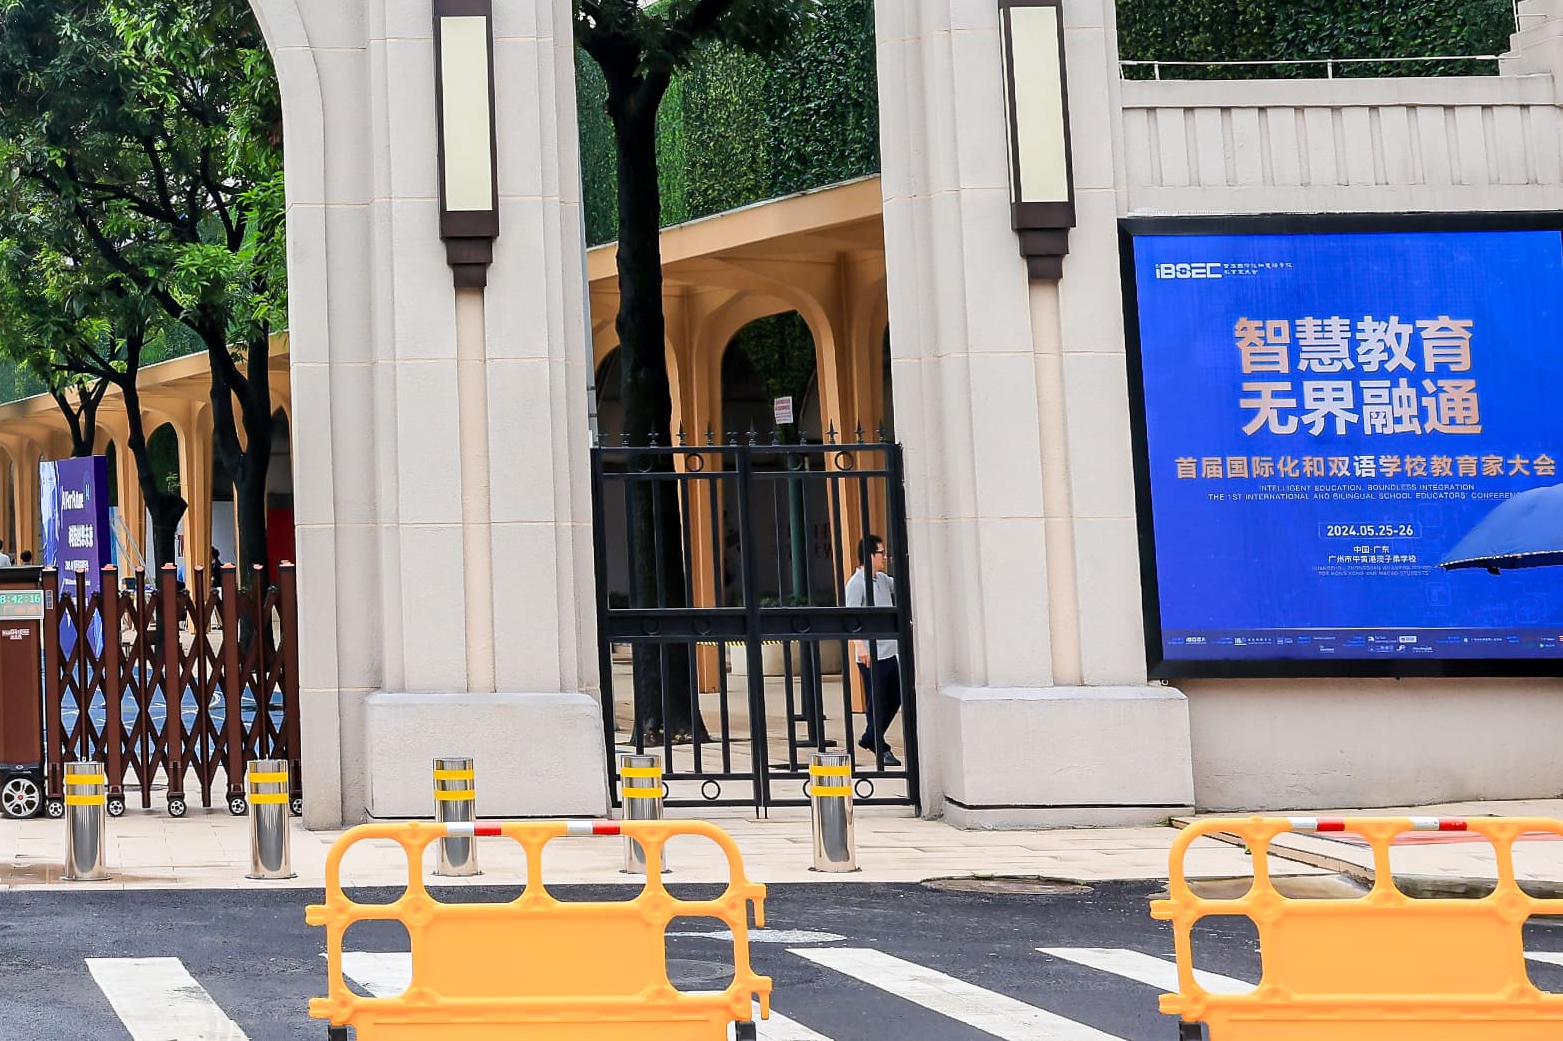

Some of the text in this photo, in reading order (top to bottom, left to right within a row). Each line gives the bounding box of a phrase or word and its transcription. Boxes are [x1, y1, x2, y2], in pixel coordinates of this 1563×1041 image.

[1234, 315, 1475, 375] 智慧教育
[1239, 378, 1483, 437] 无界融通
[1175, 454, 1556, 479] 首届国际化和双语学校教育家大会
[1207, 493, 1225, 501] THE
[1245, 492, 1309, 500] INTERNATIONAL
[1313, 492, 1330, 500] AND
[1332, 492, 1375, 500] BILINGUAL
[1378, 492, 1411, 500] SCHOOL
[1367, 483, 1417, 491] BOUNDLESS
[1419, 483, 1475, 491] INTEGRATION
[1326, 524, 1414, 537] 2024.05.25-26
